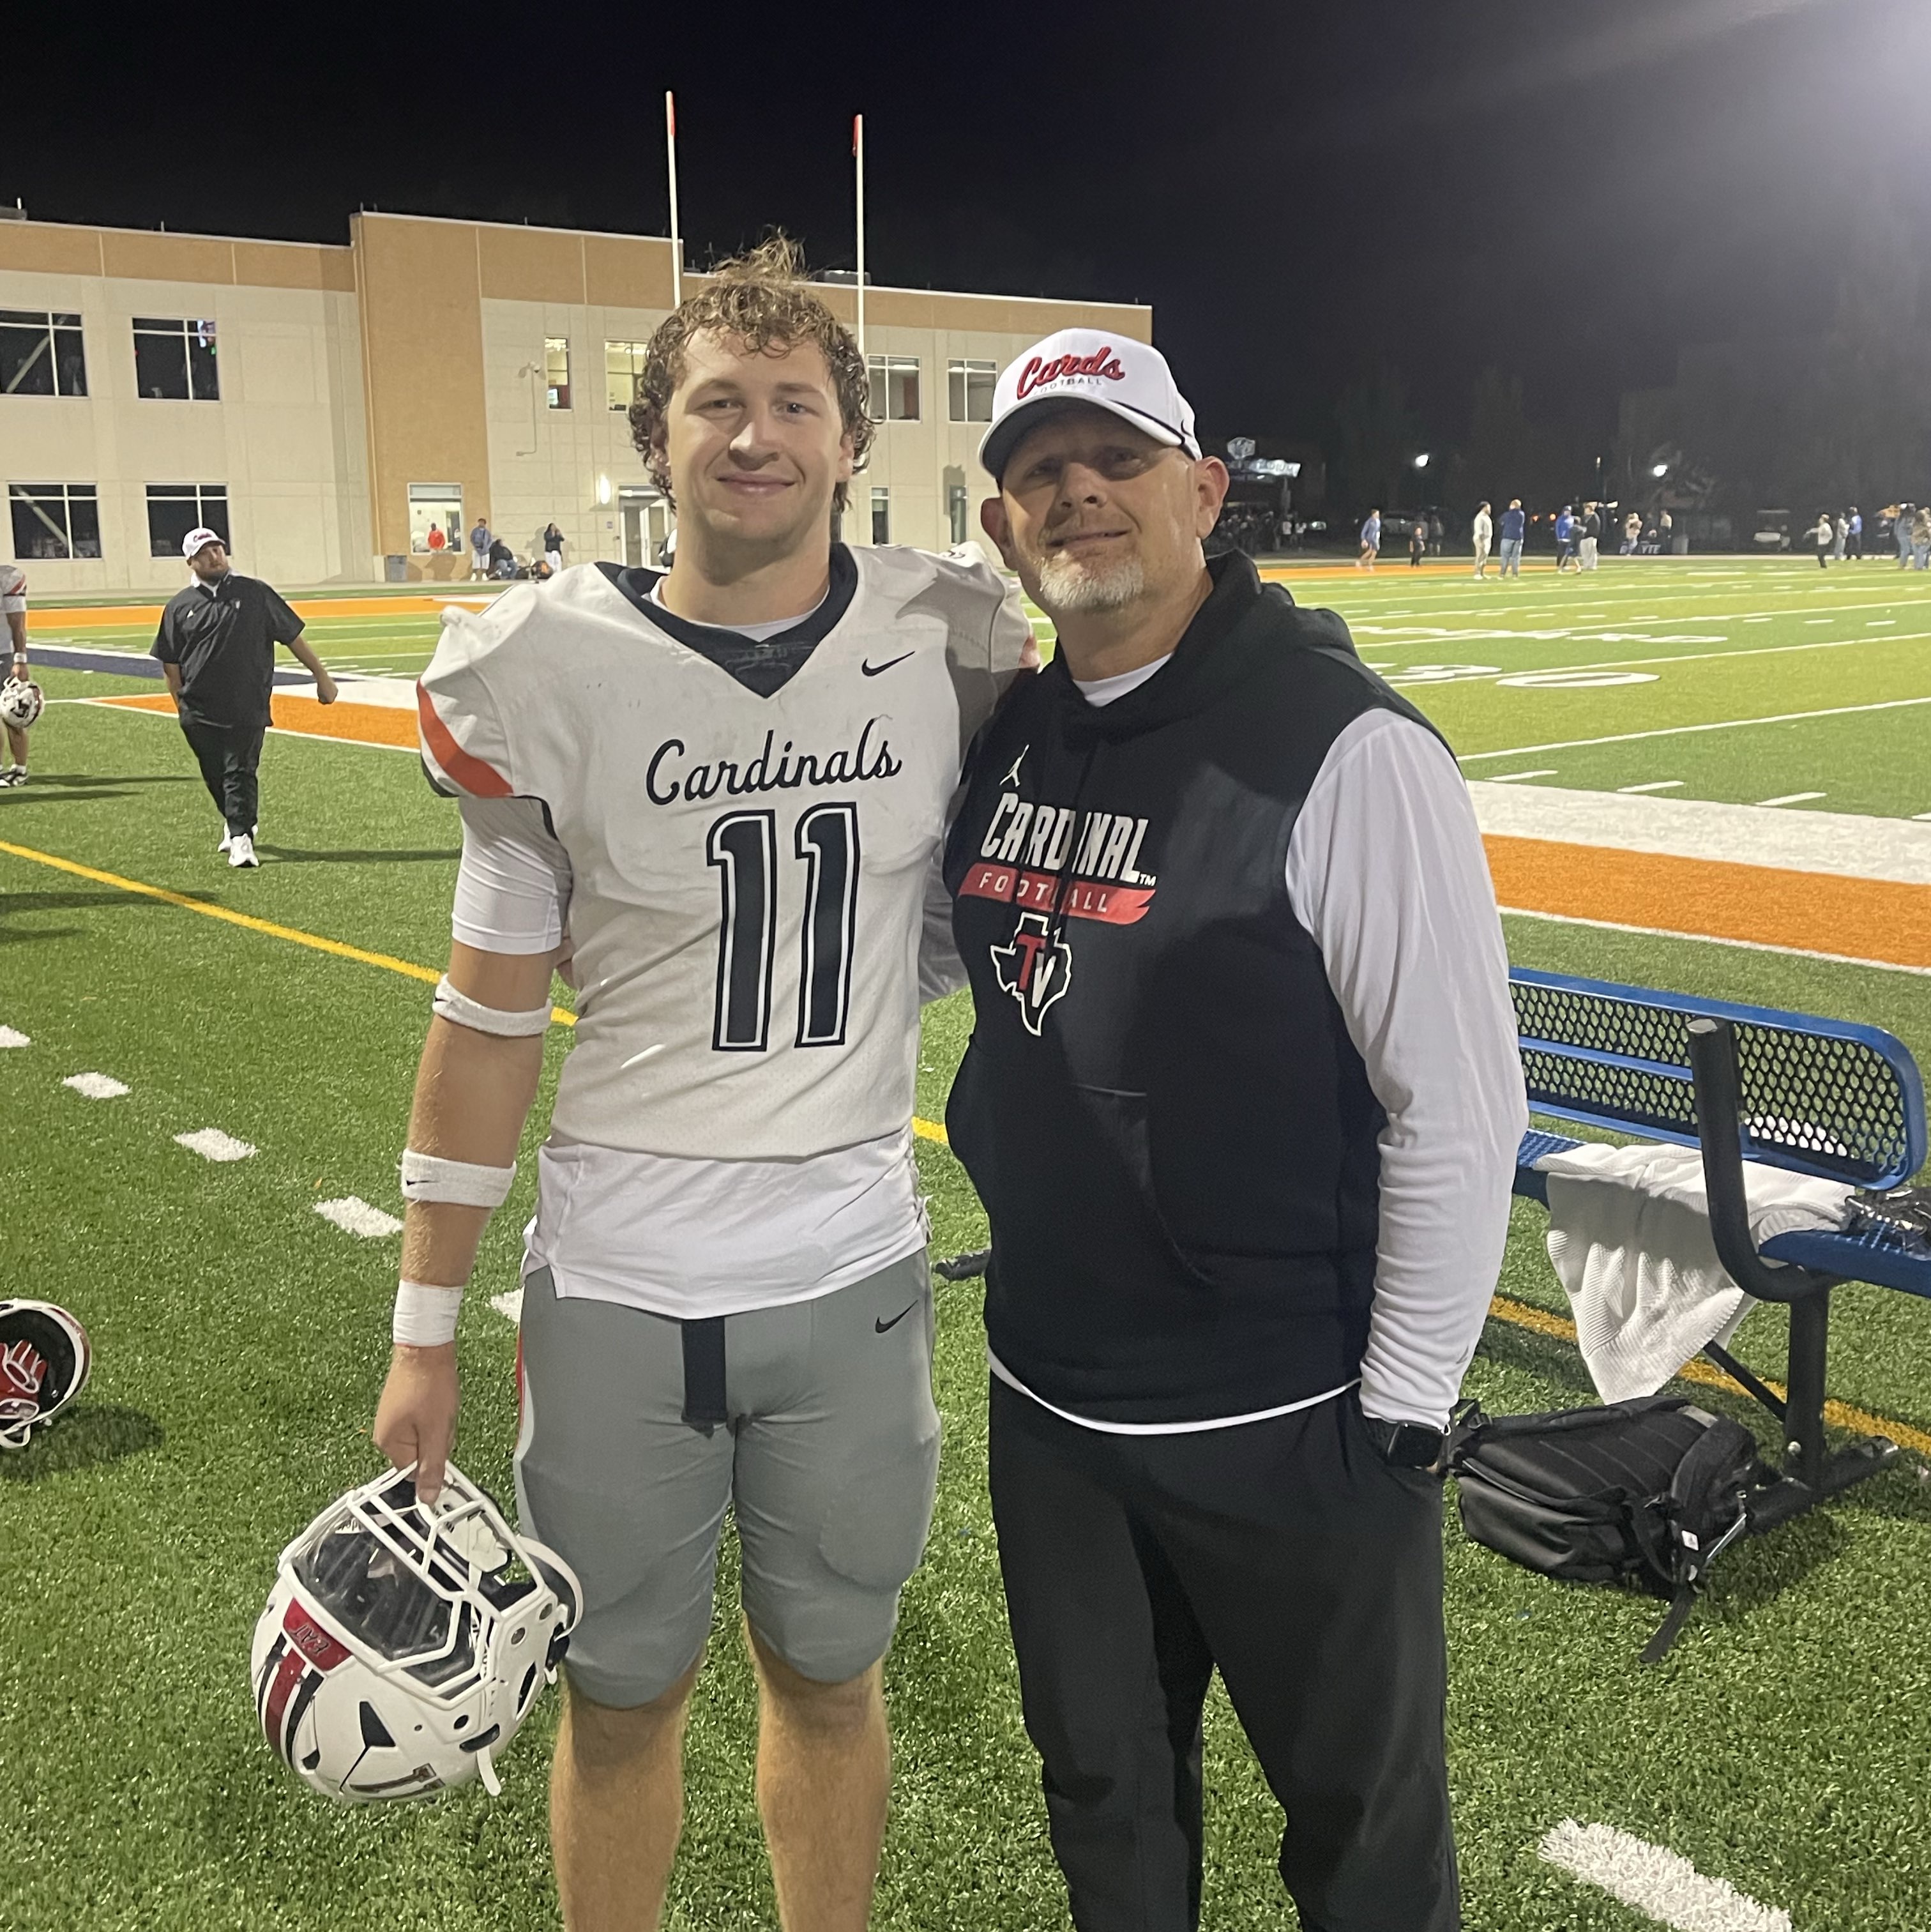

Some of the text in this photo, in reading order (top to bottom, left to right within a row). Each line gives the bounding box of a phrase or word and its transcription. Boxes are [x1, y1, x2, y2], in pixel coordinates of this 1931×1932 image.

[1017, 346, 1126, 400] Cards
[646, 714, 902, 805] Cardinals
[706, 802, 860, 1052] 11
[978, 872, 1108, 913] FOOTALL
